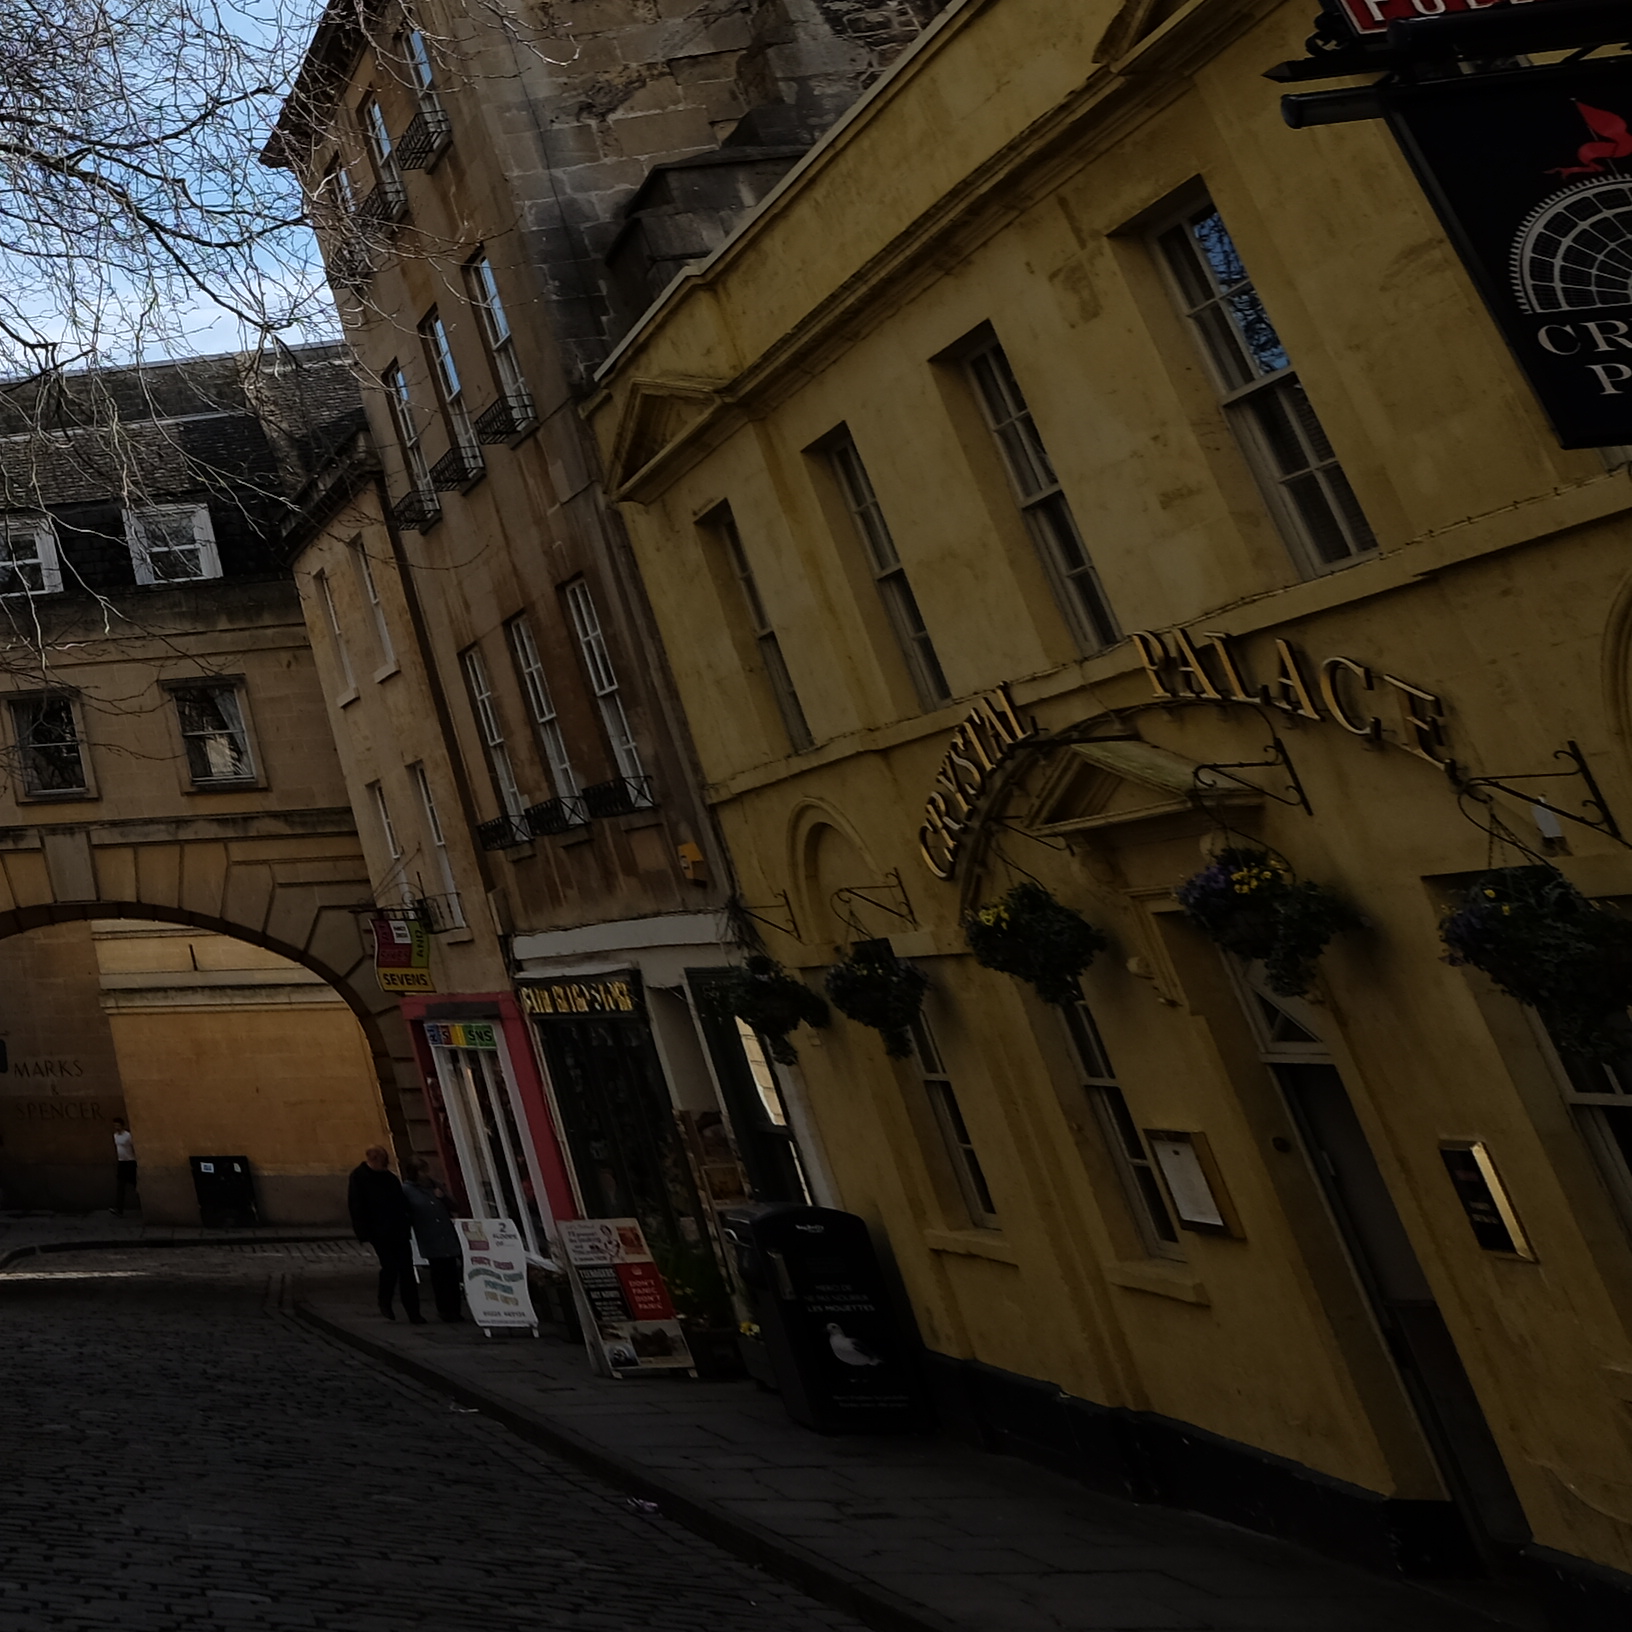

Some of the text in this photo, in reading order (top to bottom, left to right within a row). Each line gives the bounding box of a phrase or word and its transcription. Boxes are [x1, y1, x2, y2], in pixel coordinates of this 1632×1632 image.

[1537, 318, 1632, 355] CR
[918, 628, 1456, 882] CRYSTAL PALACE
[415, 929, 424, 958] AND
[383, 973, 429, 986] SEVENS
[14, 1059, 84, 1077] MARKS
[16, 1102, 106, 1121] SPENCER
[499, 1222, 507, 1233] 2
[632, 1288, 658, 1296] PANIC
[637, 1303, 664, 1311] PANIC
[807, 1304, 876, 1313] LES MOUETTES
